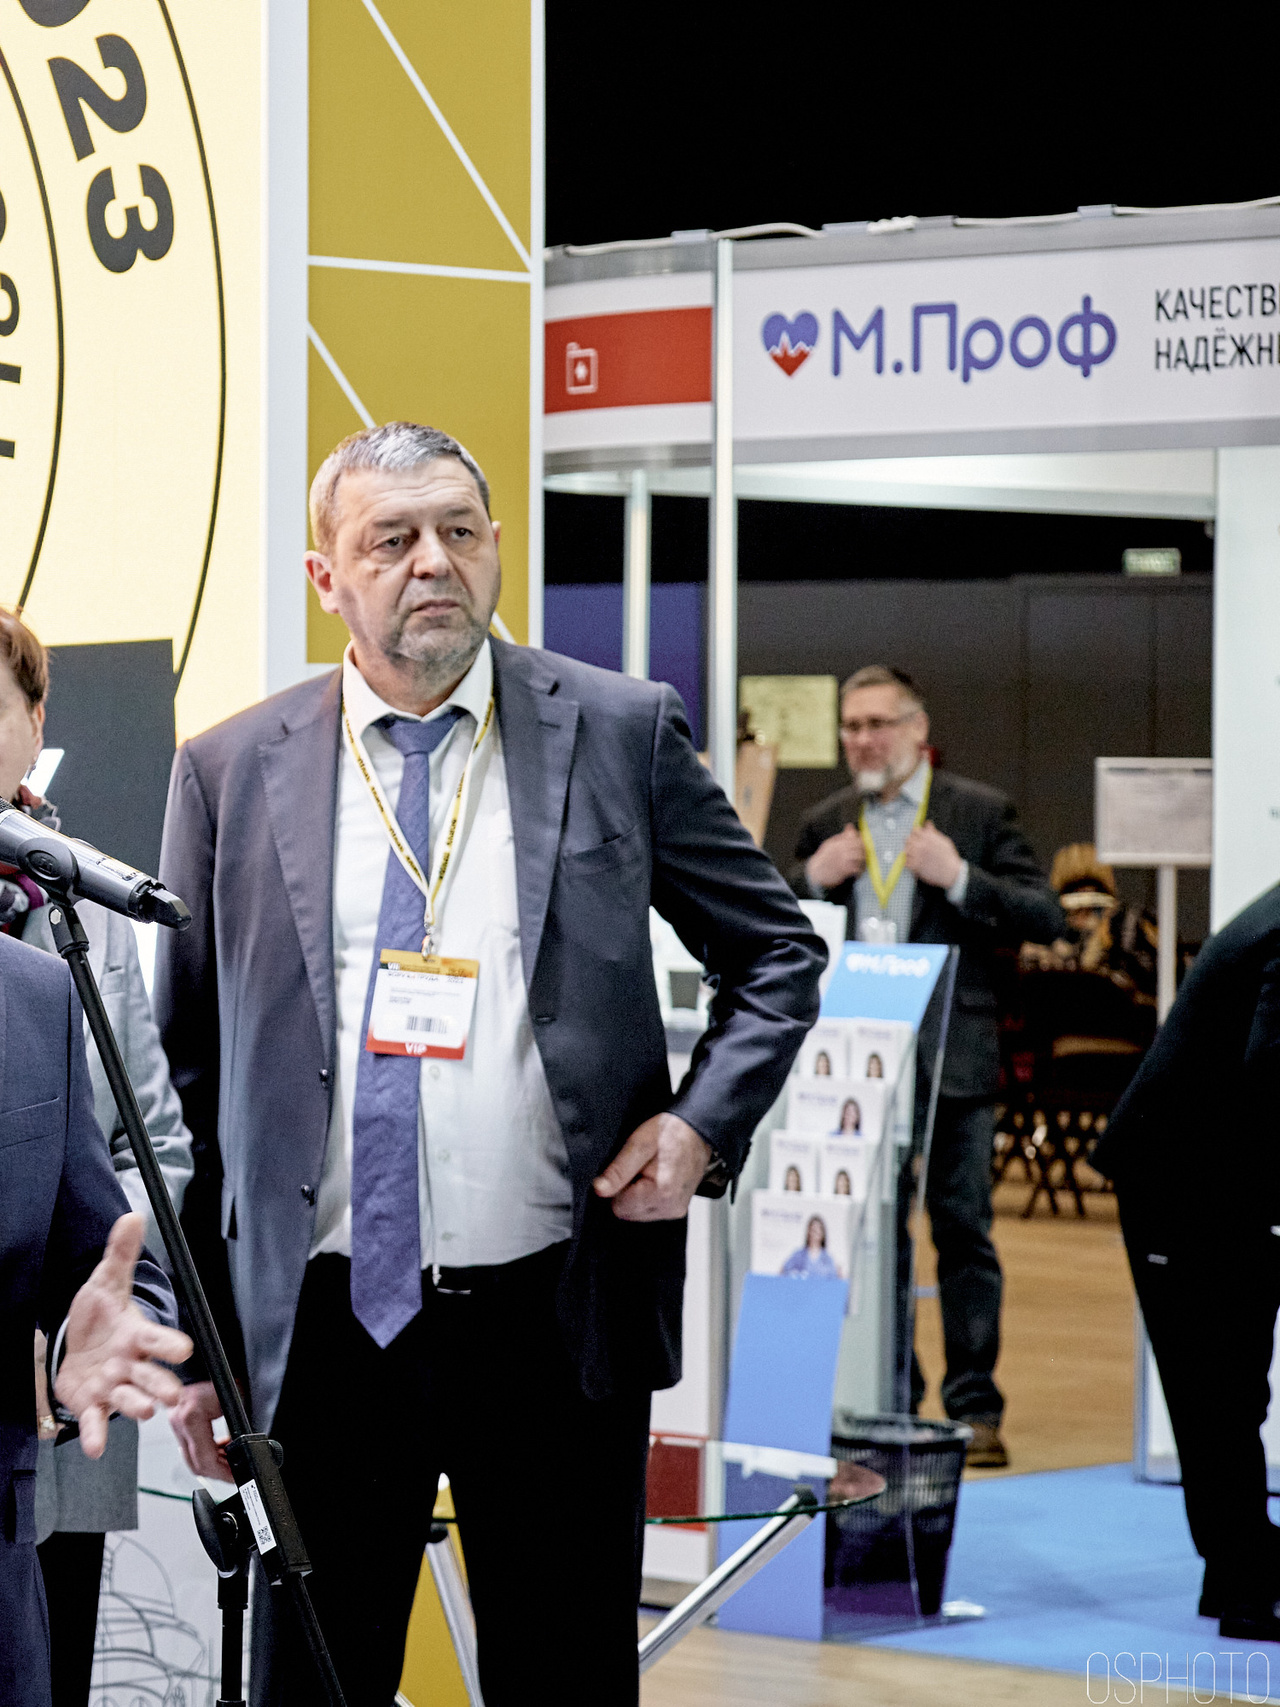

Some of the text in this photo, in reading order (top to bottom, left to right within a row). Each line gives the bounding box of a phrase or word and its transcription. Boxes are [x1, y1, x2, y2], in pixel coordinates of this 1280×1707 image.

[22, 0, 174, 274] 23
[1156, 284, 1280, 320] КАЧЕСТВ
[832, 294, 1117, 383] М.Проф
[1155, 327, 1280, 373] НАДЁЖН
